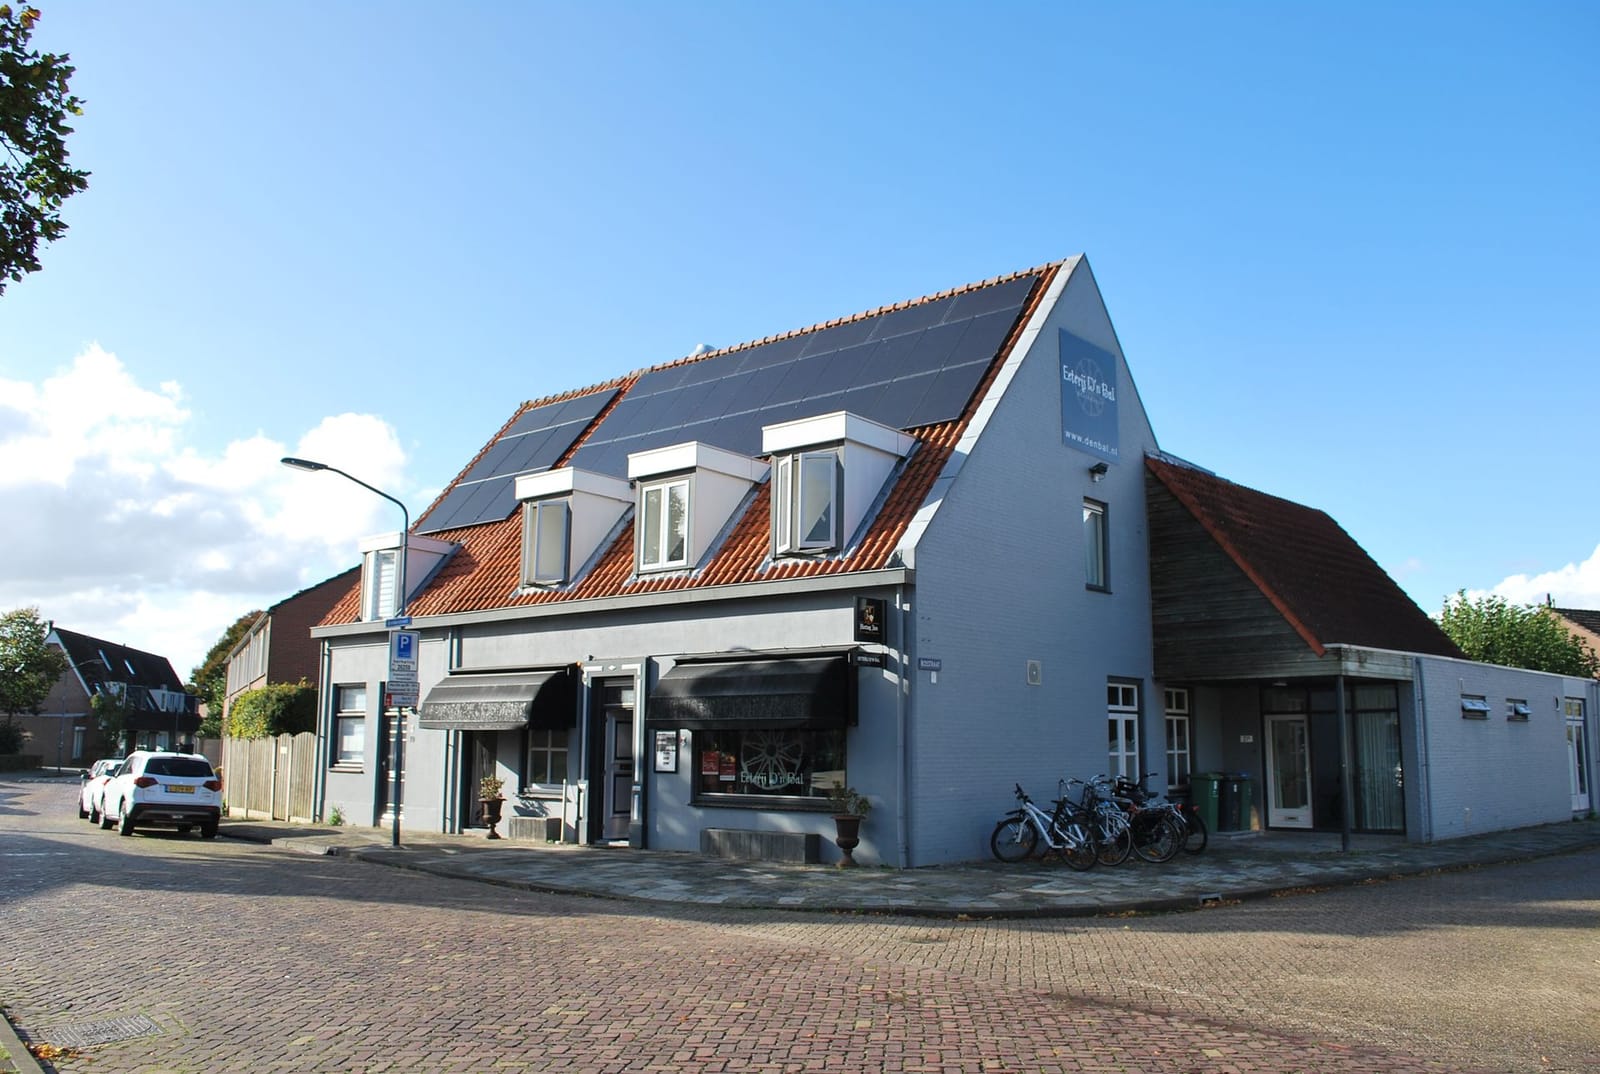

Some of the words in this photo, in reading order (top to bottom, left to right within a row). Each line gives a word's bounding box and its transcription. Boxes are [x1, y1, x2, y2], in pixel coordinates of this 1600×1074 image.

[1101, 382, 1115, 401] Bal
[1065, 432, 1118, 457] www.denbal.nl
[400, 636, 409, 649] P
[787, 771, 804, 785] Bal
